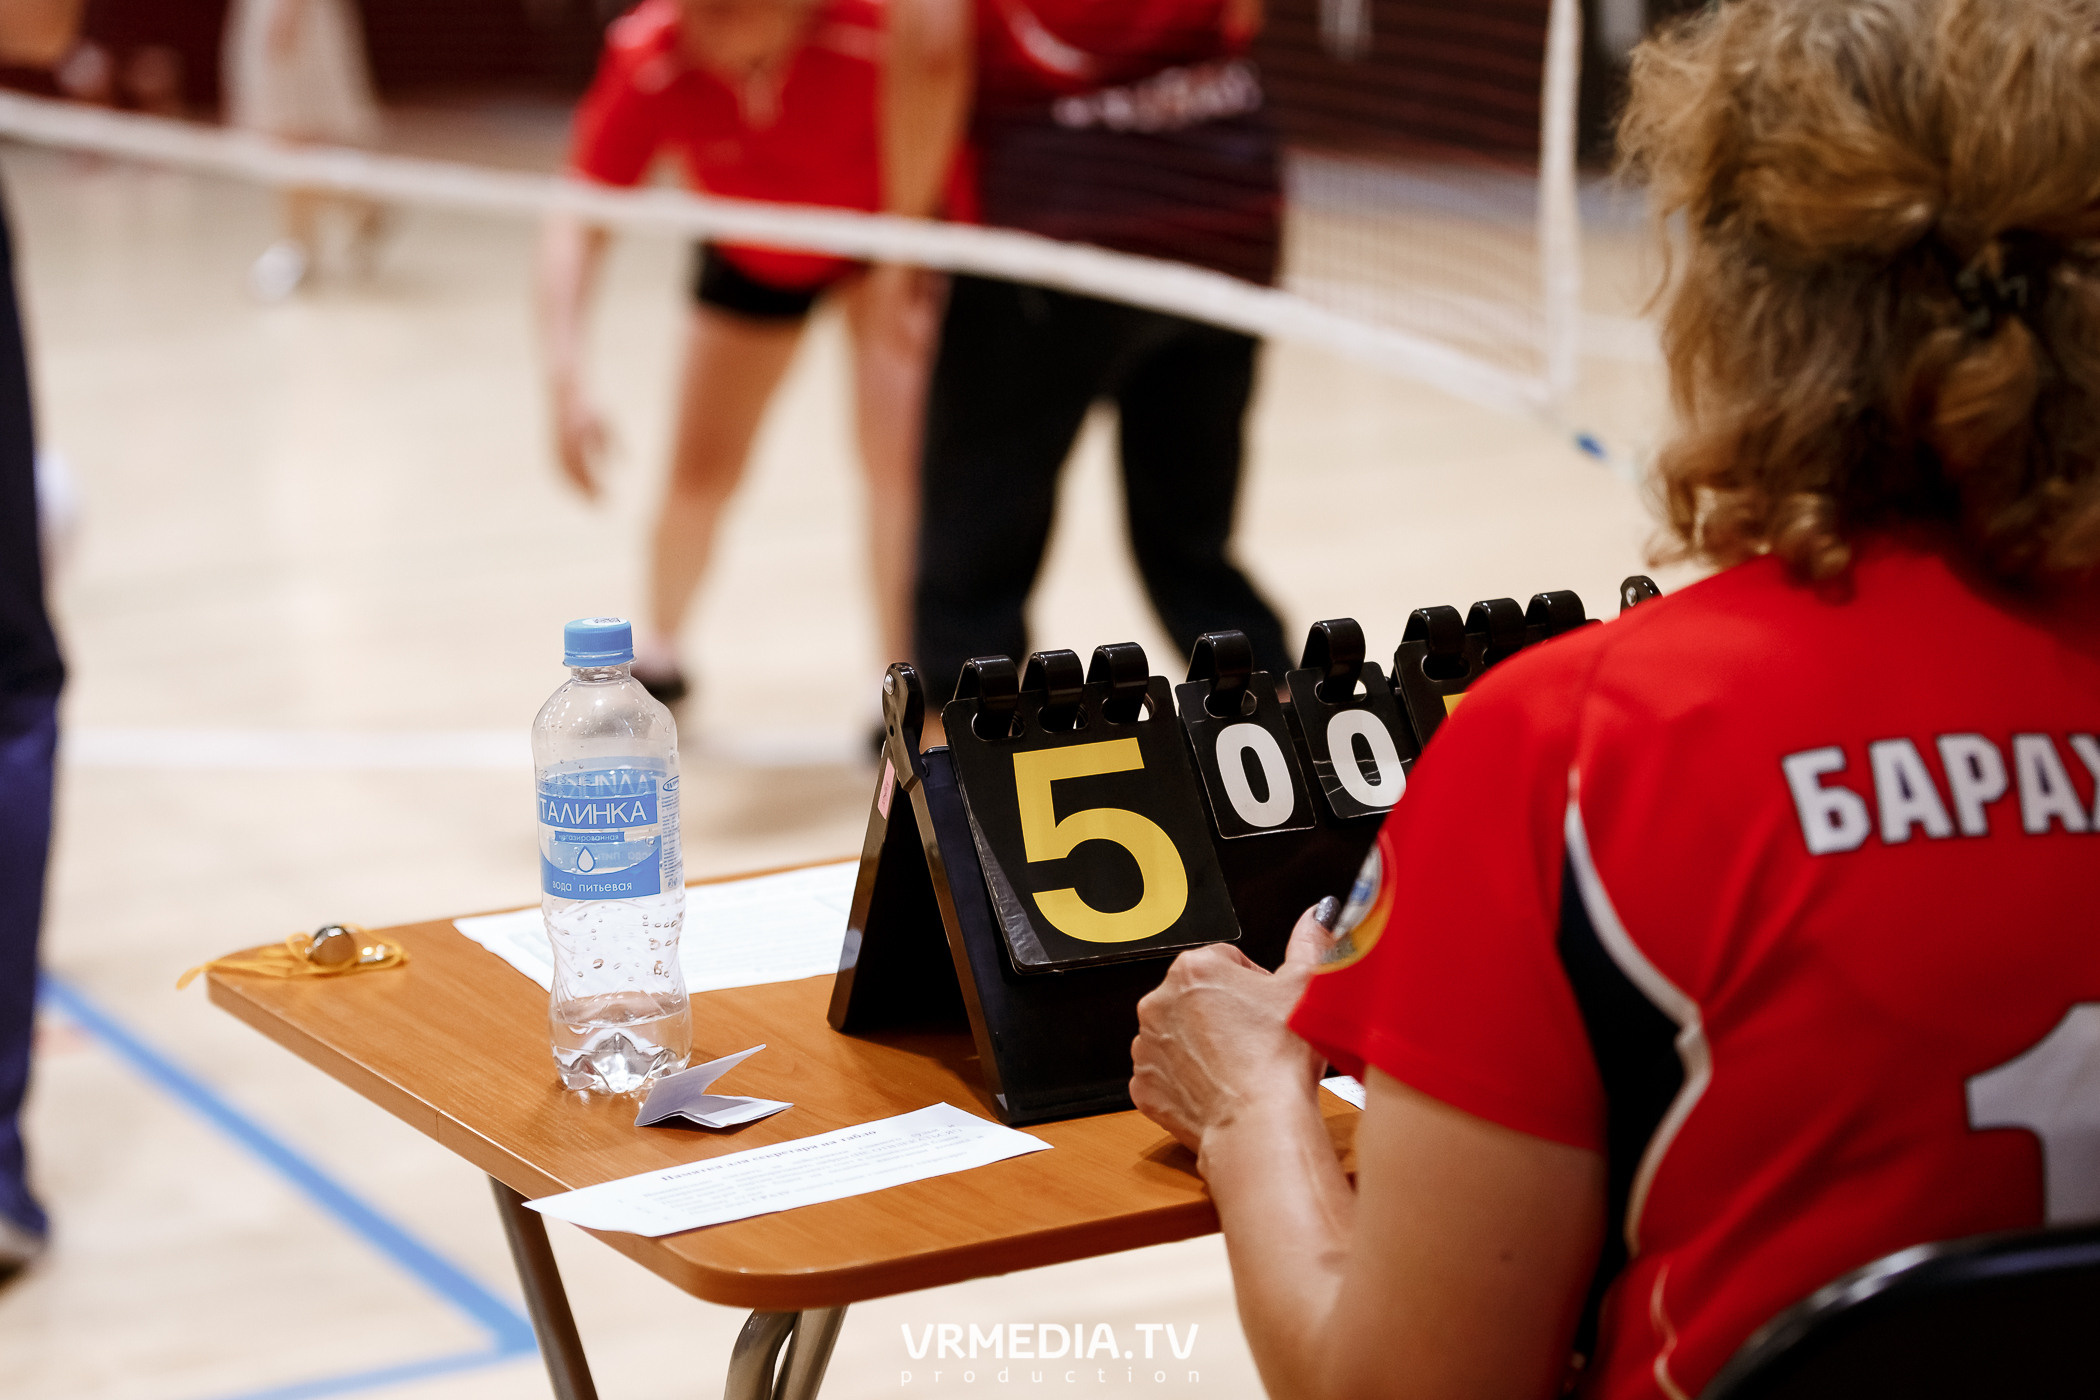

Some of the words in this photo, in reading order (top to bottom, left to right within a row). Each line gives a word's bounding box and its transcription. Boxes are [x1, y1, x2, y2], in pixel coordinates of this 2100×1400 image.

[1216, 723, 1295, 828] 0
[1327, 708, 1406, 808] 0
[539, 797, 648, 825] ТАЛИНКА
[1012, 736, 1189, 944] 5
[552, 881, 572, 893] вода
[579, 880, 632, 893] питьевая
